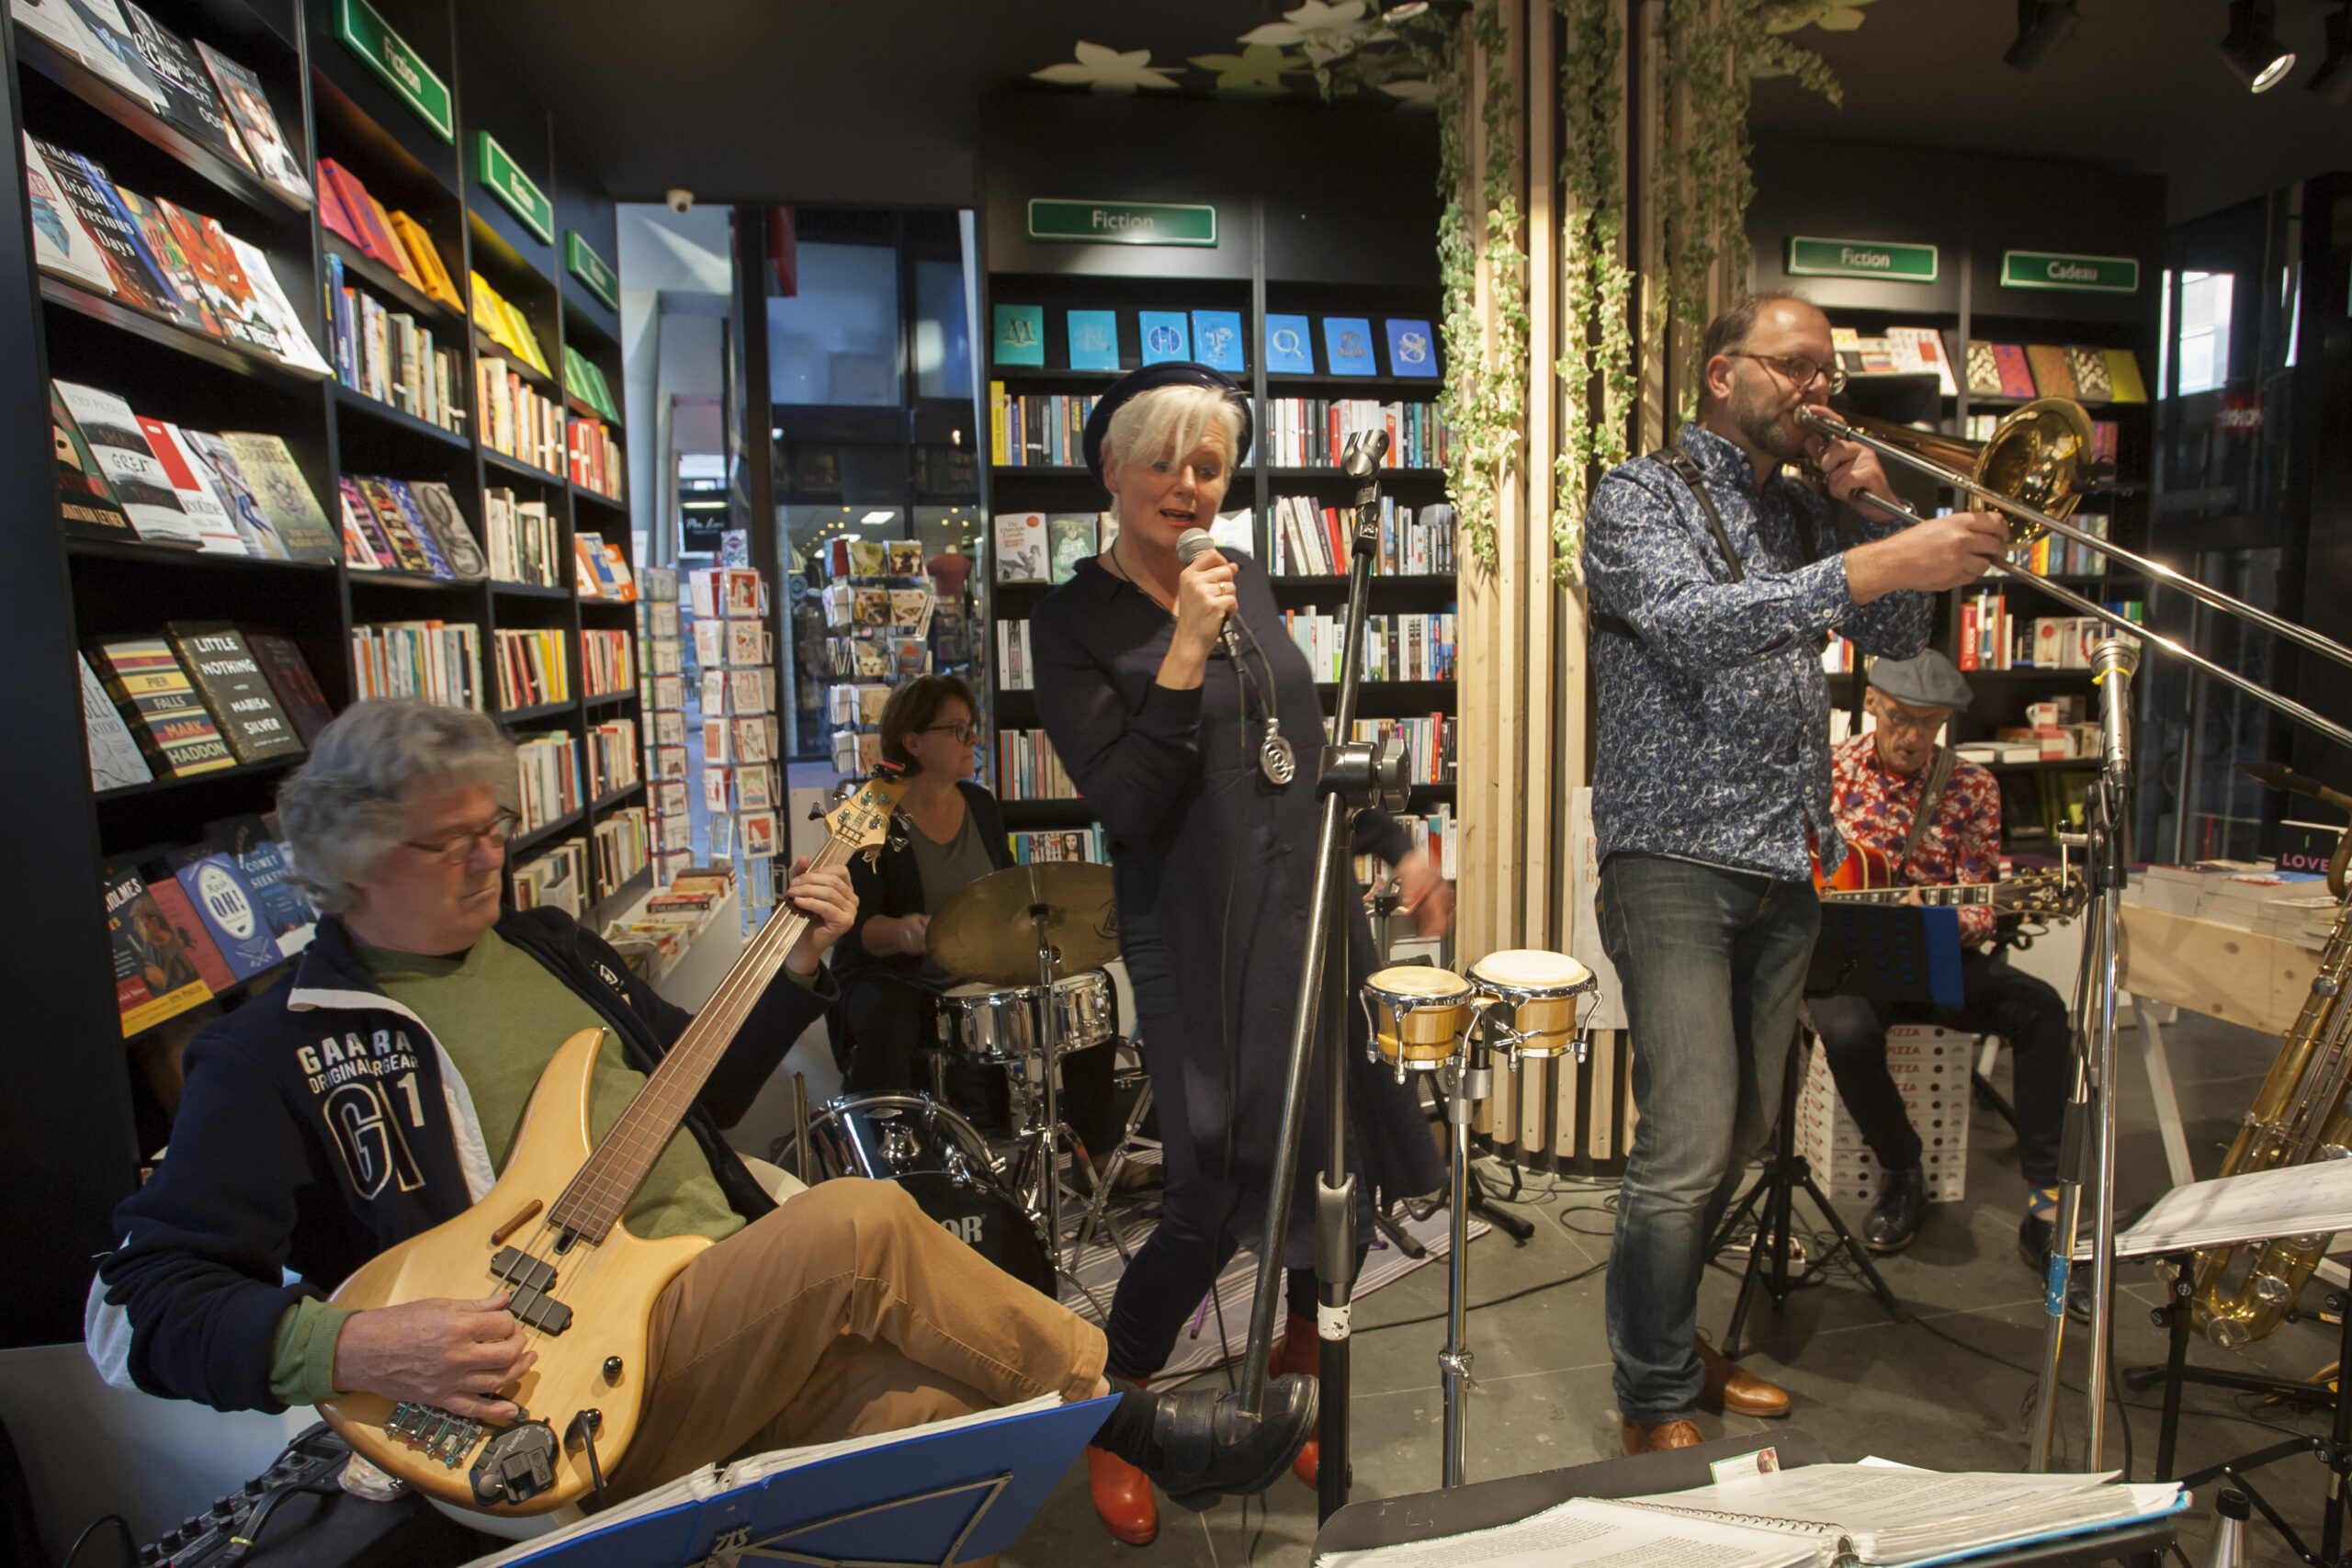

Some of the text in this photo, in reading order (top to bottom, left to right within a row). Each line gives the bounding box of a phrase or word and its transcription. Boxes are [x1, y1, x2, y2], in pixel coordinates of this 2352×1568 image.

[383, 36, 421, 94] Fiction
[55, 171, 118, 212] Bright,
[67, 197, 135, 235] Precious
[1092, 209, 1154, 230] Fiction
[95, 227, 136, 257] Days
[1840, 248, 1890, 269] Fiction
[2047, 261, 2098, 282] Cadeau
[112, 453, 155, 477] GREAT
[193, 637, 239, 653] LITTLE
[200, 659, 258, 675] NOTHING
[145, 676, 171, 688] PIER
[153, 695, 186, 710] FALLS
[231, 697, 272, 714] MARISA
[163, 720, 207, 739] MARK
[243, 717, 281, 735] SILVER
[166, 741, 228, 764] HADDON
[2282, 852, 2330, 873] LOVE
[210, 889, 245, 918] OH!
